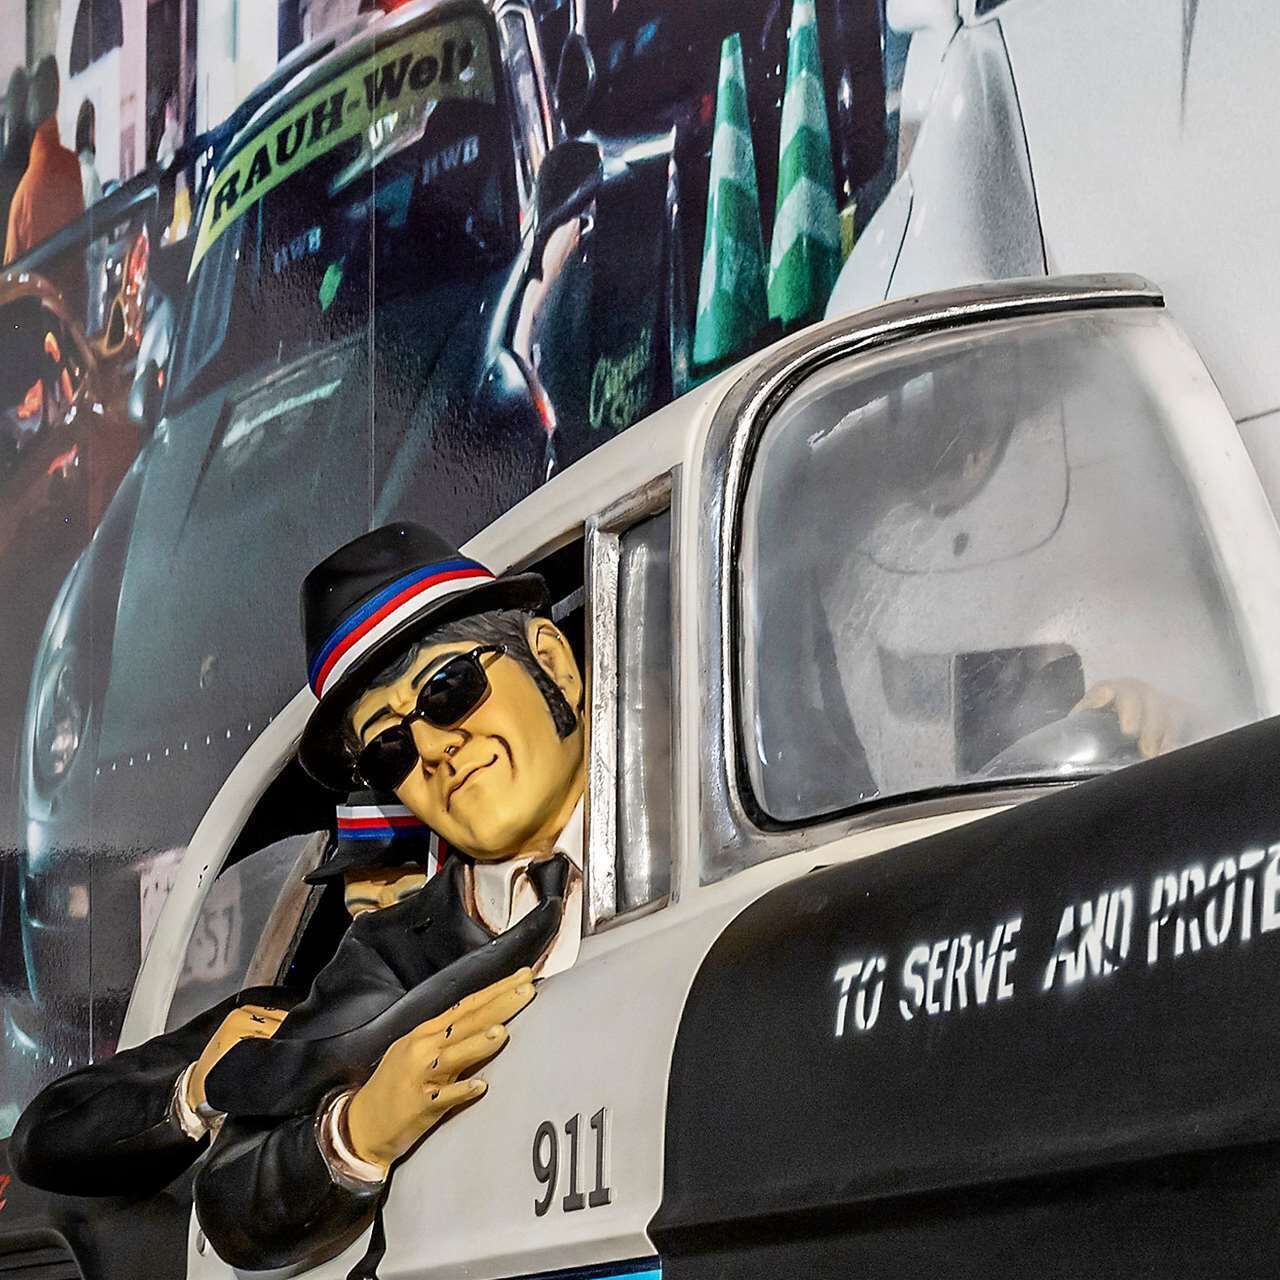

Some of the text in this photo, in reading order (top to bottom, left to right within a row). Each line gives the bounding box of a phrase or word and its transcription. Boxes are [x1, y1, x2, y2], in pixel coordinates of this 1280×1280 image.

[834, 956, 887, 1037] TO
[899, 915, 1023, 1021] SERVE
[1042, 885, 1133, 991] AND
[532, 1105, 612, 1217] 911
